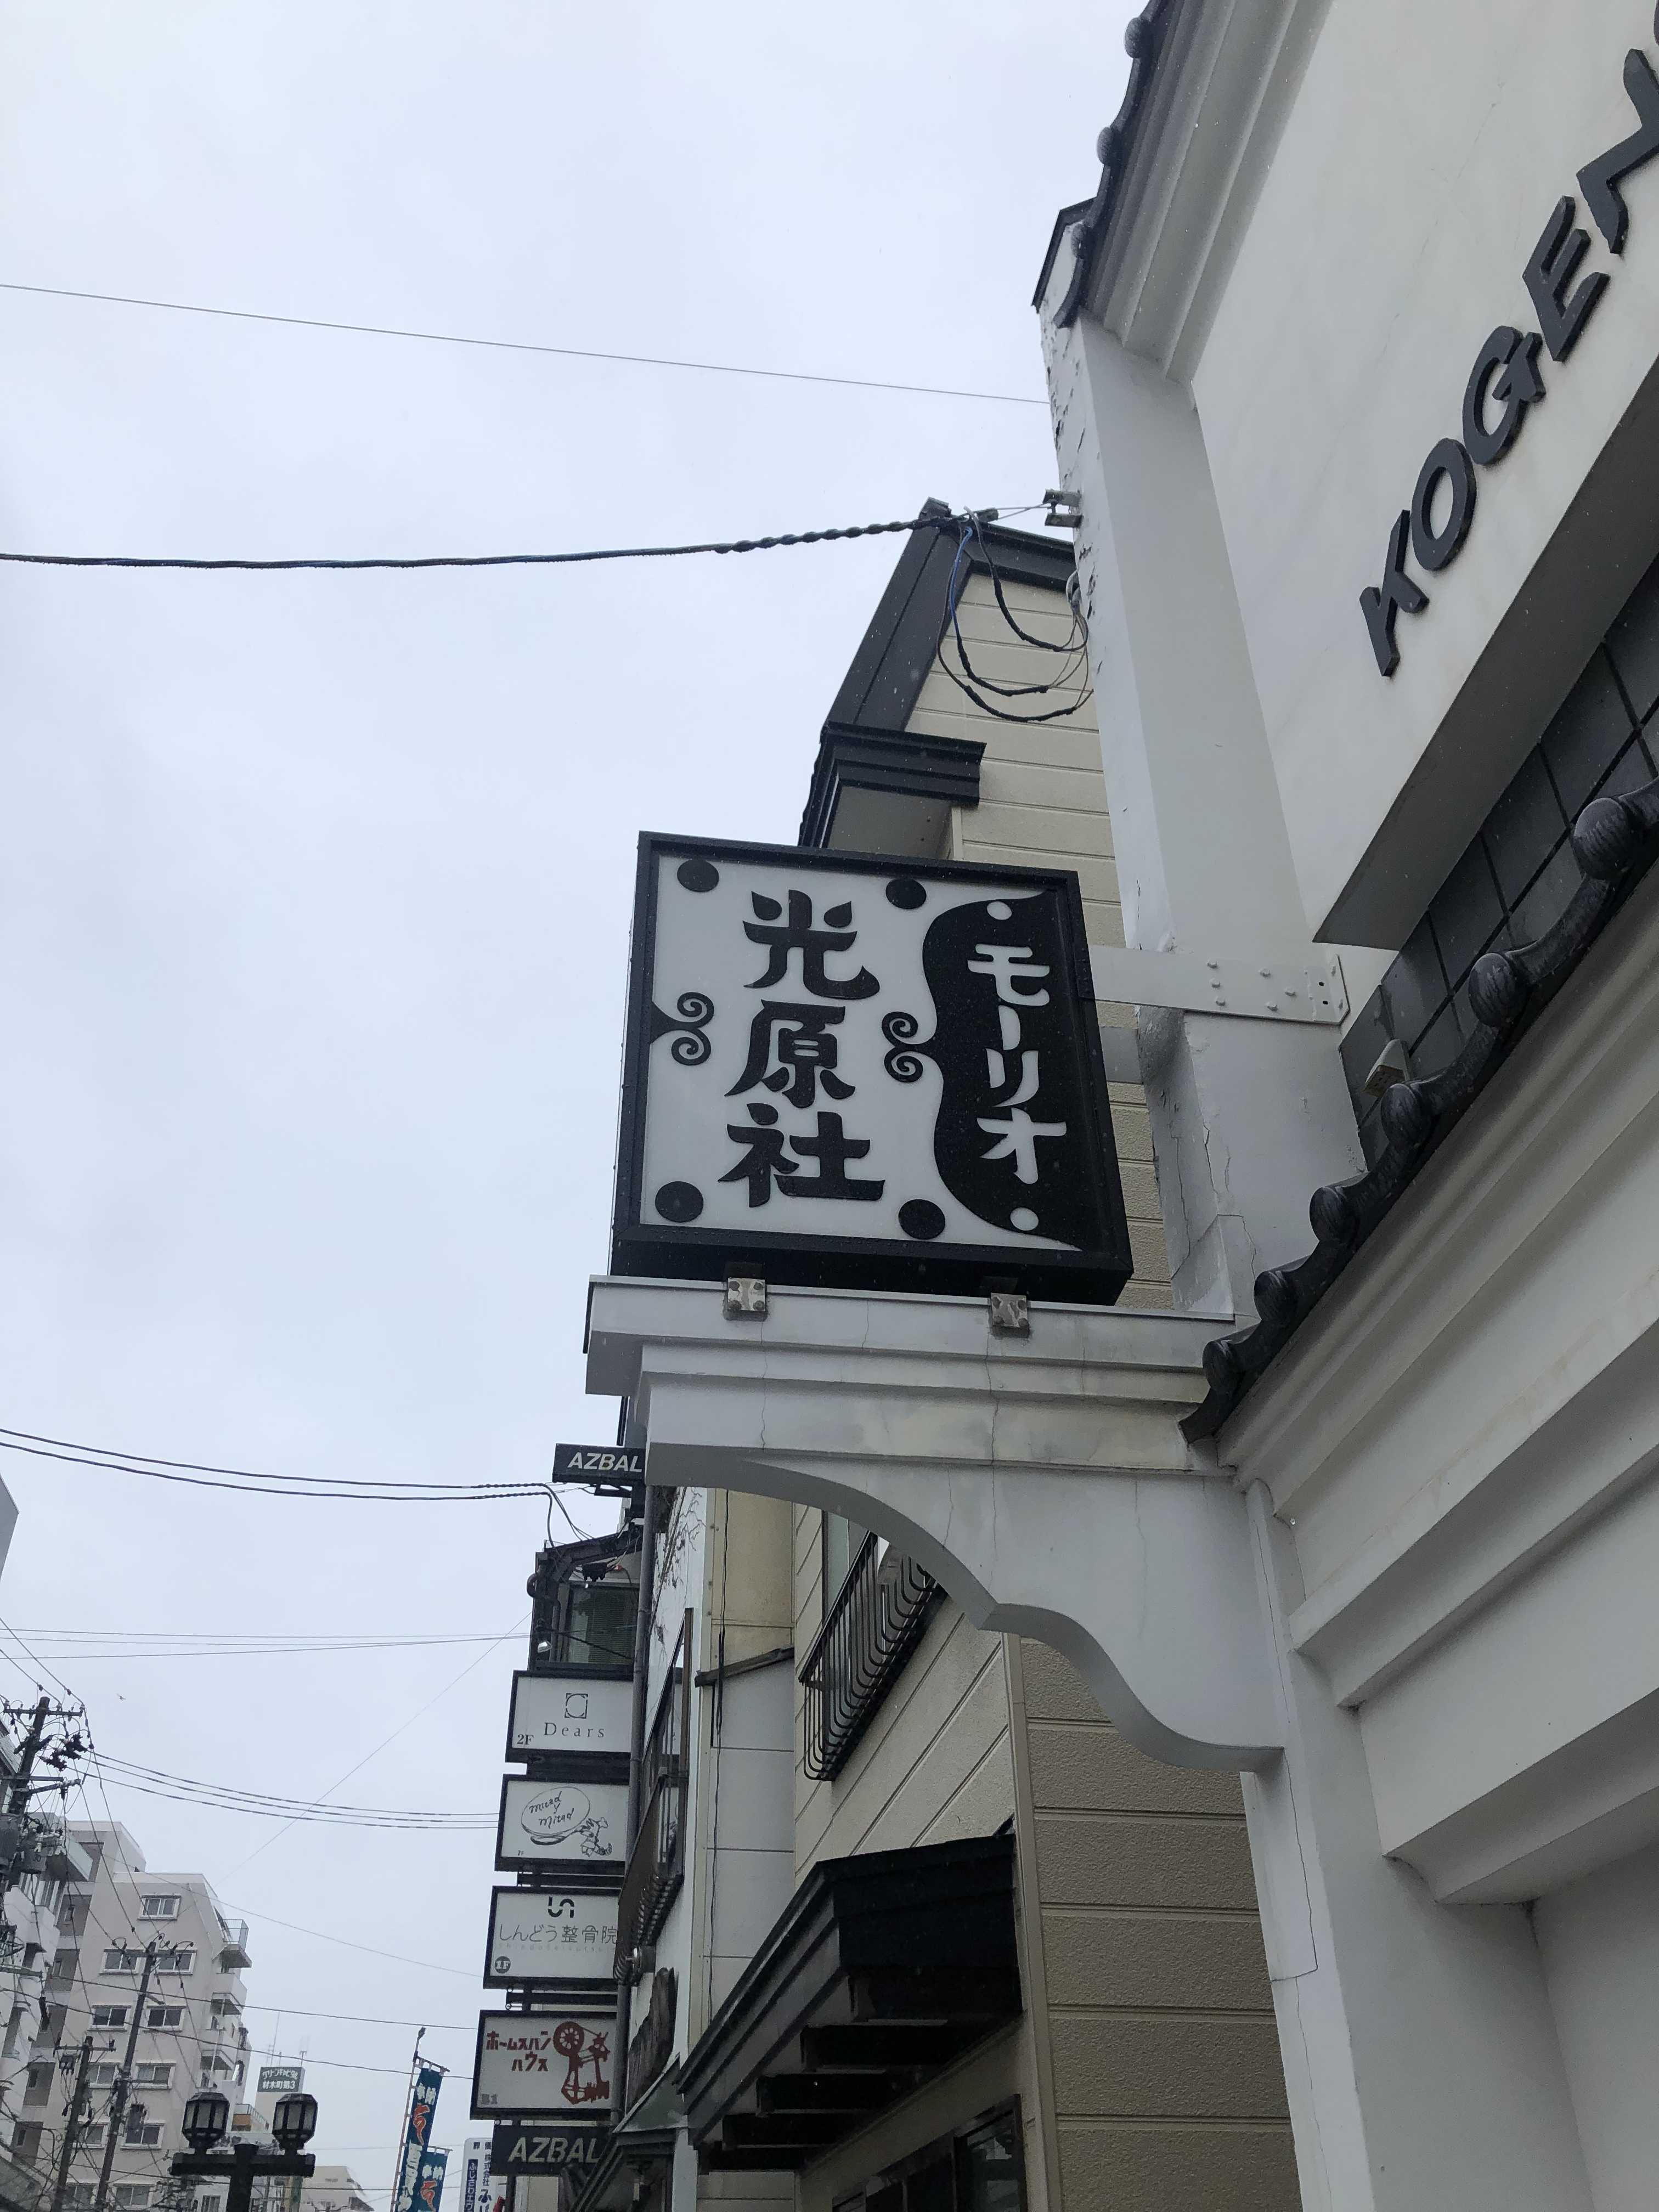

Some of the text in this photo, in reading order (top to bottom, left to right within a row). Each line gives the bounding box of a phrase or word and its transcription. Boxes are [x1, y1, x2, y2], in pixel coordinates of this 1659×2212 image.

[1359, 0, 1659, 677] KOGEN
[718, 889, 885, 1208] 光原社
[967, 943, 1067, 1184] モーリオ
[567, 1452, 642, 1472] AZBAL
[517, 1734, 534, 1745] 2F
[544, 1722, 605, 1738] Dears
[499, 1924, 617, 1945] しんどう整骨院
[496, 1960, 510, 1970] 1F
[511, 2051, 549, 2072] ハウス
[507, 2137, 601, 2163] AZBAL
